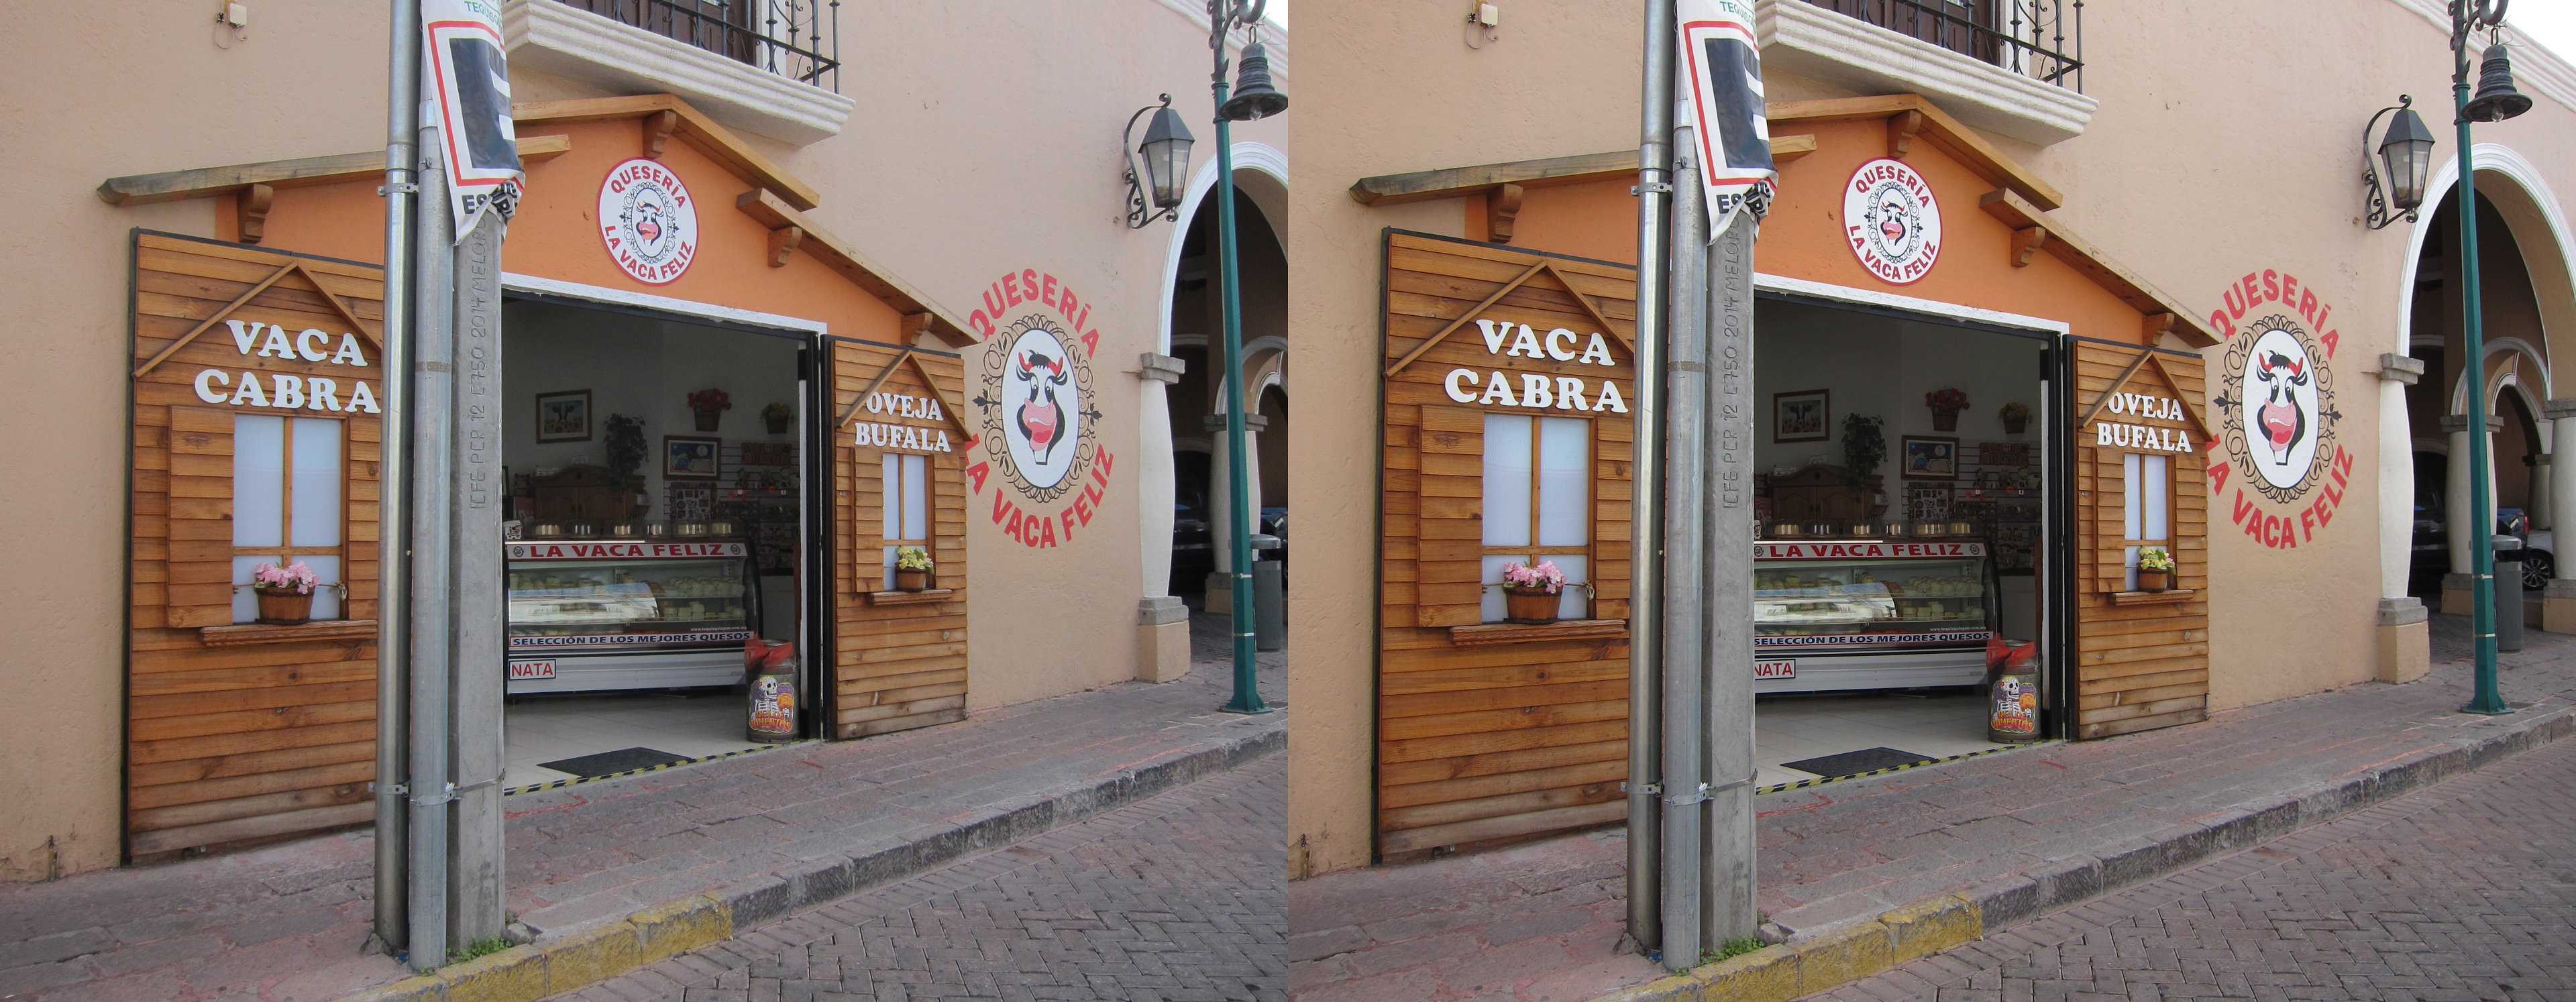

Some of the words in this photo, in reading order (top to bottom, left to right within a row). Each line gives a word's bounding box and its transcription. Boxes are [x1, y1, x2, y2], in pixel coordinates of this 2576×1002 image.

[611, 166, 686, 208] QUESERÍA
[1856, 166, 1929, 208] QUESERÍA
[605, 225, 621, 250] LA
[620, 249, 657, 280] VACA
[660, 241, 692, 279] FELIZ
[1849, 225, 1865, 249] LA
[1864, 249, 1901, 280] VACA
[1904, 240, 1936, 279] FELIZ
[471, 297, 486, 338] 2014
[969, 268, 1099, 359] QUESERÍA
[1724, 297, 1739, 337] 2014
[2210, 268, 2339, 360] QUESERÍA
[226, 320, 368, 366] VACA
[1476, 319, 1615, 366] VACA
[195, 369, 381, 413] CABRA
[866, 391, 943, 421] OVEJA
[1445, 368, 1629, 413] CABRA
[2108, 391, 2185, 421] OVEJA
[470, 404, 485, 421] 12
[1723, 404, 1737, 421] 12
[855, 423, 951, 452] BUFALA
[2097, 423, 2192, 453] BUFALA
[965, 433, 989, 496] LA
[991, 487, 1057, 549] VACA
[1060, 443, 1114, 542] FELIZ
[2206, 433, 2231, 496] LA
[2232, 488, 2296, 549] VACA
[2300, 444, 2353, 542] FELIZ
[530, 545, 564, 557] LA
[572, 545, 645, 557] VACA
[652, 544, 724, 557] FELIZ
[1770, 545, 1803, 557] LA
[1811, 545, 1884, 557] VACA
[1892, 544, 1964, 556] FELIZ
[513, 636, 586, 645] SELECCIÓN
[637, 634, 696, 643] MEJORES
[700, 632, 750, 641] QUESOS
[1754, 635, 1828, 645] SELECCIÓN
[1877, 634, 1936, 643] MEJORES
[1939, 632, 1990, 641] QUESOS
[511, 662, 553, 677] NATA
